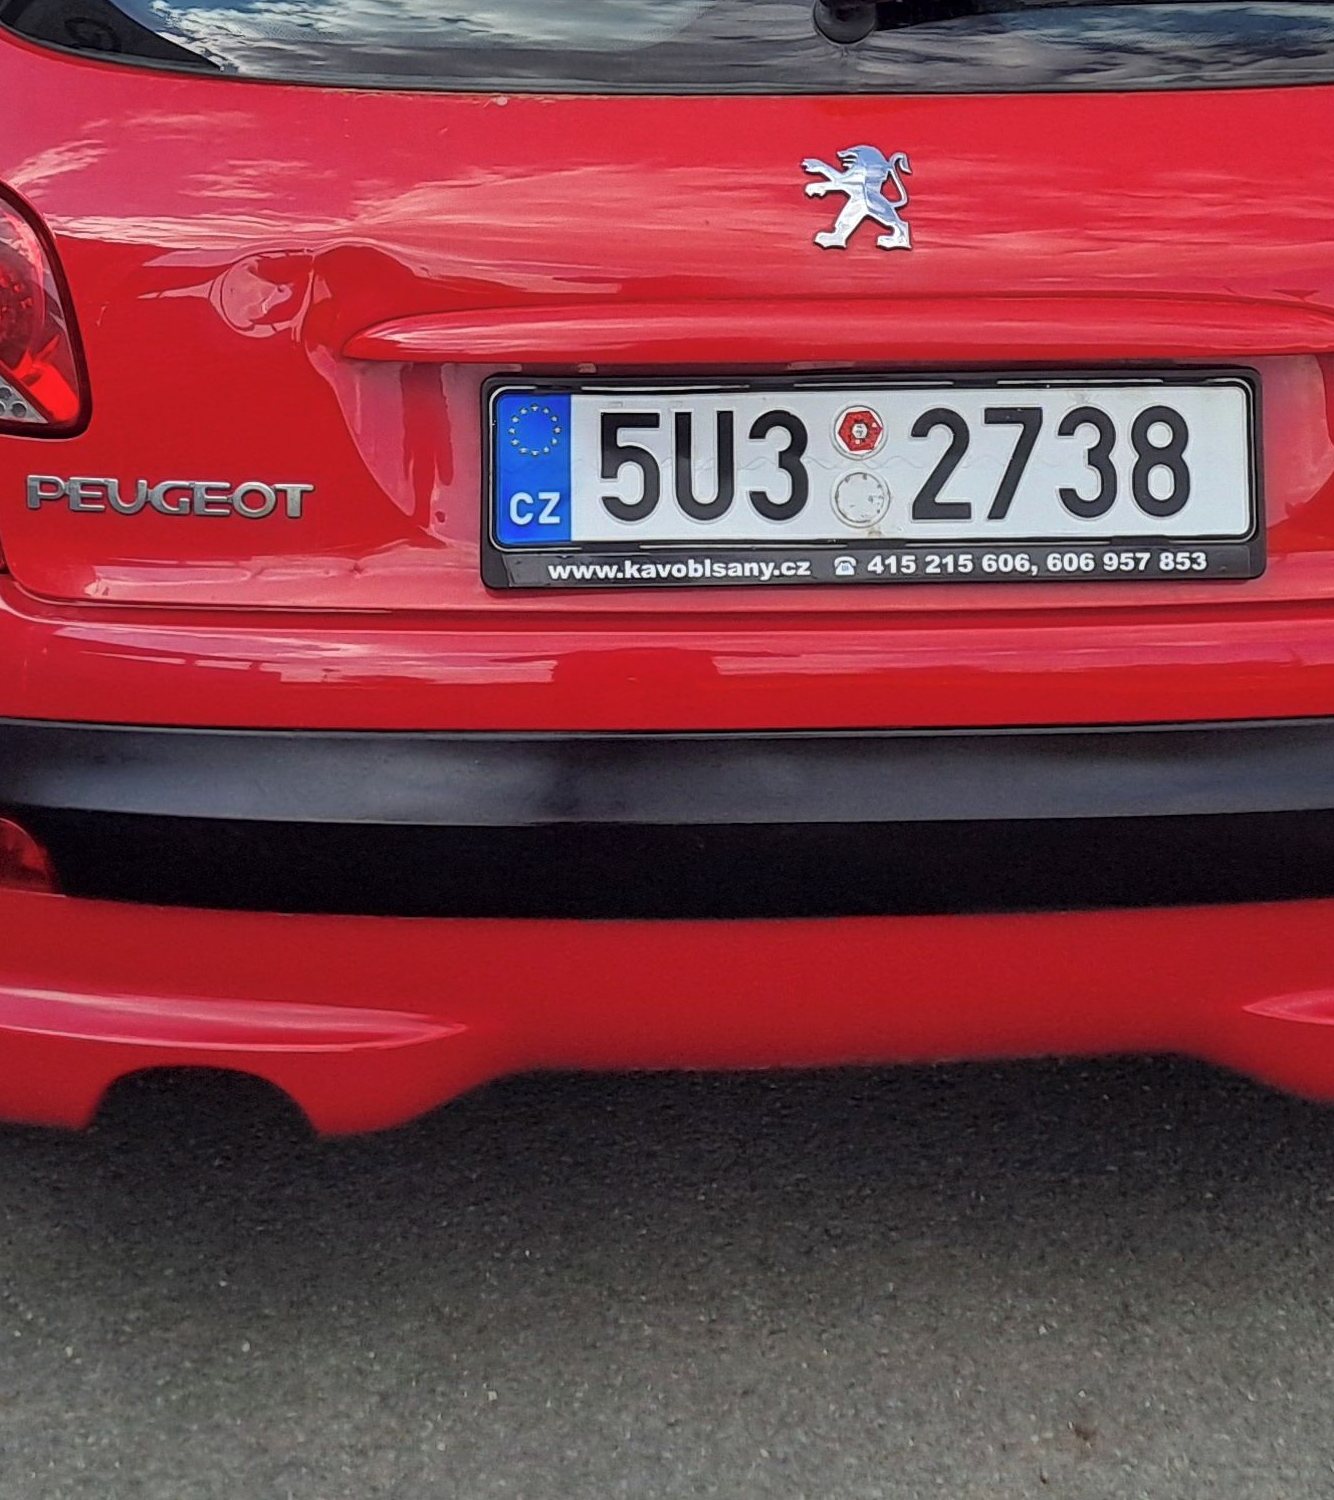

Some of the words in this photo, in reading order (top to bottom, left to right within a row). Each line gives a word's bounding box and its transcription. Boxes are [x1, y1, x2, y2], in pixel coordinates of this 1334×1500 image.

[600, 409, 809, 522] 5U3
[910, 405, 1192, 520] 2738
[26, 474, 315, 519] PEUGEOT
[509, 491, 561, 525] CZ
[548, 559, 812, 581] www.kavoblsany.cz
[867, 555, 916, 575] 415
[924, 554, 974, 574] 215
[981, 554, 1039, 576] 606,
[1045, 553, 1096, 573] 606
[1102, 552, 1151, 573] 957
[1159, 551, 1208, 571] 853
